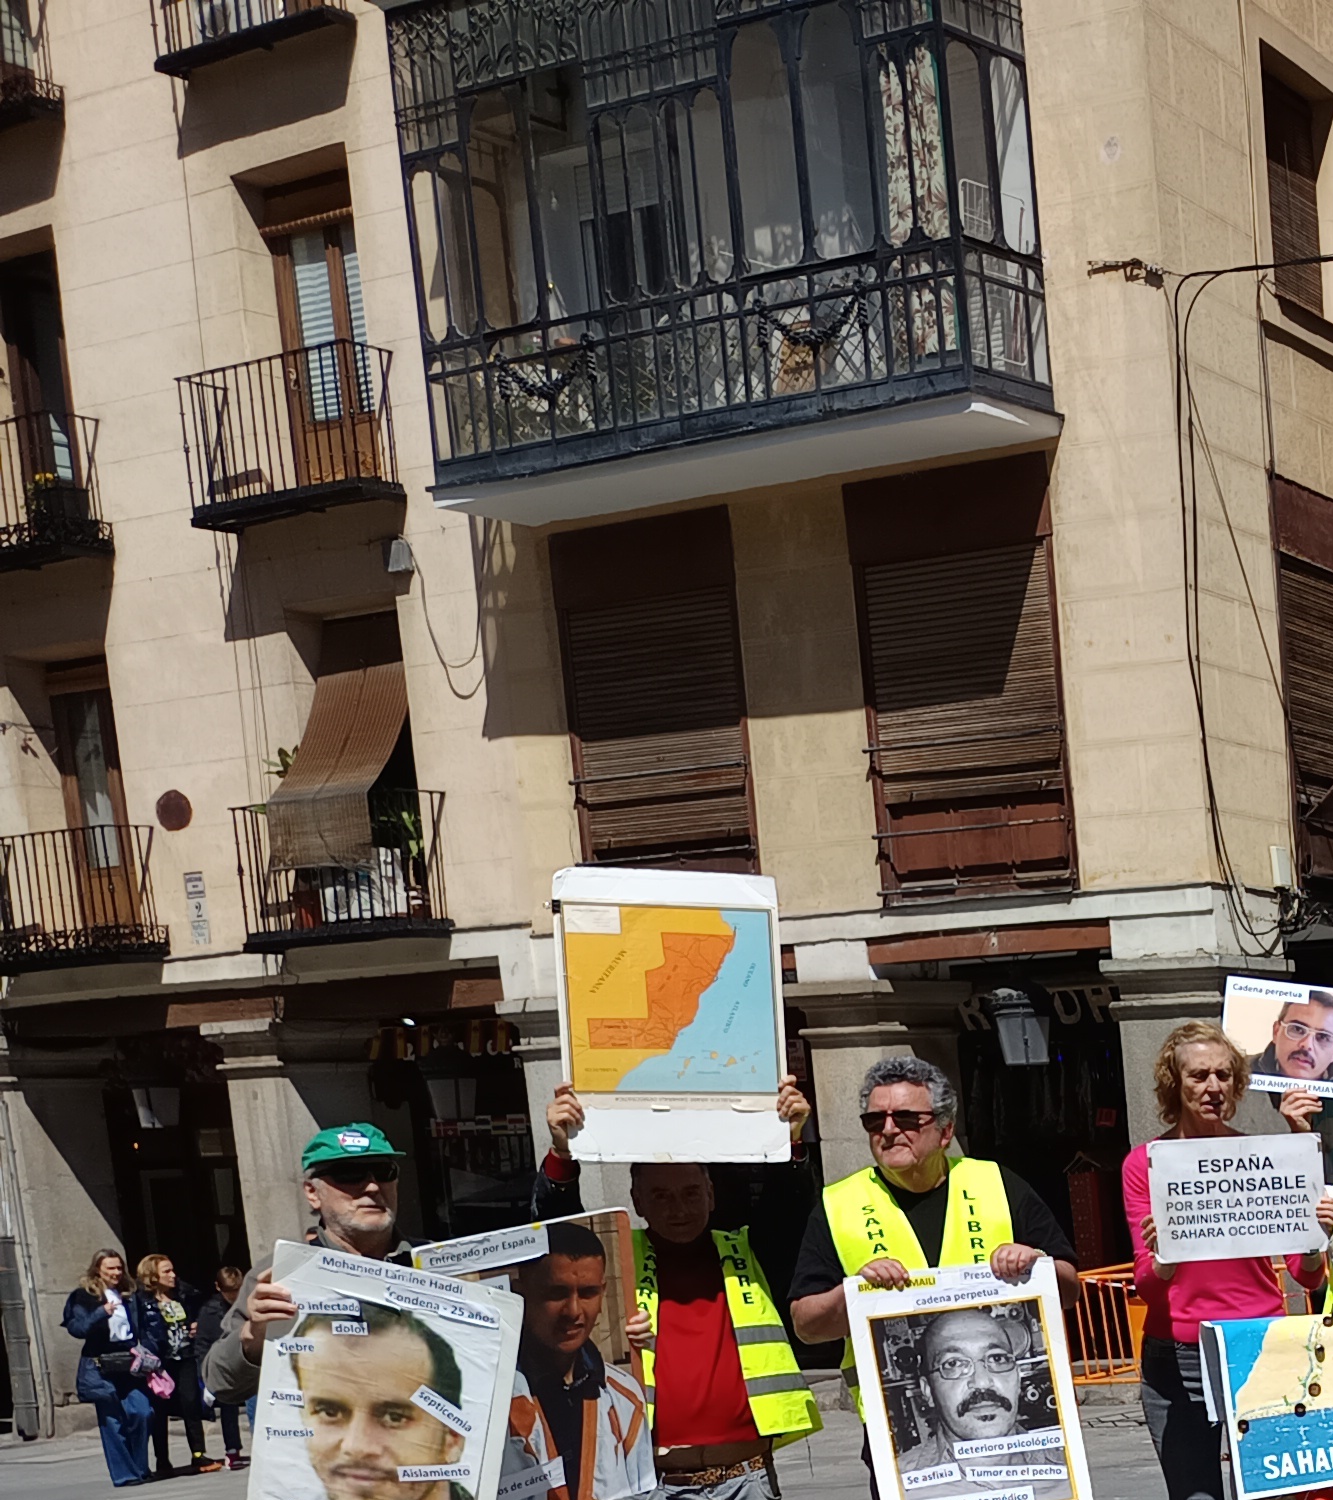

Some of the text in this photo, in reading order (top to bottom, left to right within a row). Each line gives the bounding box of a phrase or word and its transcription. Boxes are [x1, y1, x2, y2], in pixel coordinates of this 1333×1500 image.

[1232, 983, 1303, 999] Cadena perpetua
[1267, 1079, 1300, 1090] AHMED
[1198, 1154, 1274, 1173] ESPAÑA
[1168, 1175, 1306, 1196] RESPONSABLE
[1166, 1194, 1310, 1212] POR SER LA POTENCIA
[1168, 1208, 1310, 1225] ADMINISTRADORA DEL
[1171, 1222, 1309, 1240] SAHARA OCCIDENTAL
[429, 1236, 536, 1266] Entregado por España
[322, 1256, 382, 1277] Mohamed
[385, 1268, 426, 1287] Lamine
[429, 1279, 463, 1295] Haddi
[723, 1235, 754, 1304] LIBRE
[964, 1271, 991, 1279] Preso
[916, 1288, 999, 1305] cadena perpetua
[308, 1301, 360, 1313] infectado
[389, 1290, 494, 1324] Condena 25 años
[335, 1323, 366, 1334] dolor
[279, 1342, 314, 1352] fiebre
[271, 1391, 302, 1401] Asma
[418, 1390, 473, 1433] septicemia
[266, 1426, 314, 1438] Enuresis
[958, 1435, 1061, 1455] deterioro psicológico
[402, 1467, 470, 1478] Aislamiento
[907, 1469, 953, 1484] Se asfixia
[971, 1468, 1002, 1477] Tumor
[1020, 1467, 1029, 1476] el
[1032, 1466, 1062, 1477] pecho
[511, 1471, 551, 1493] de cárcel
